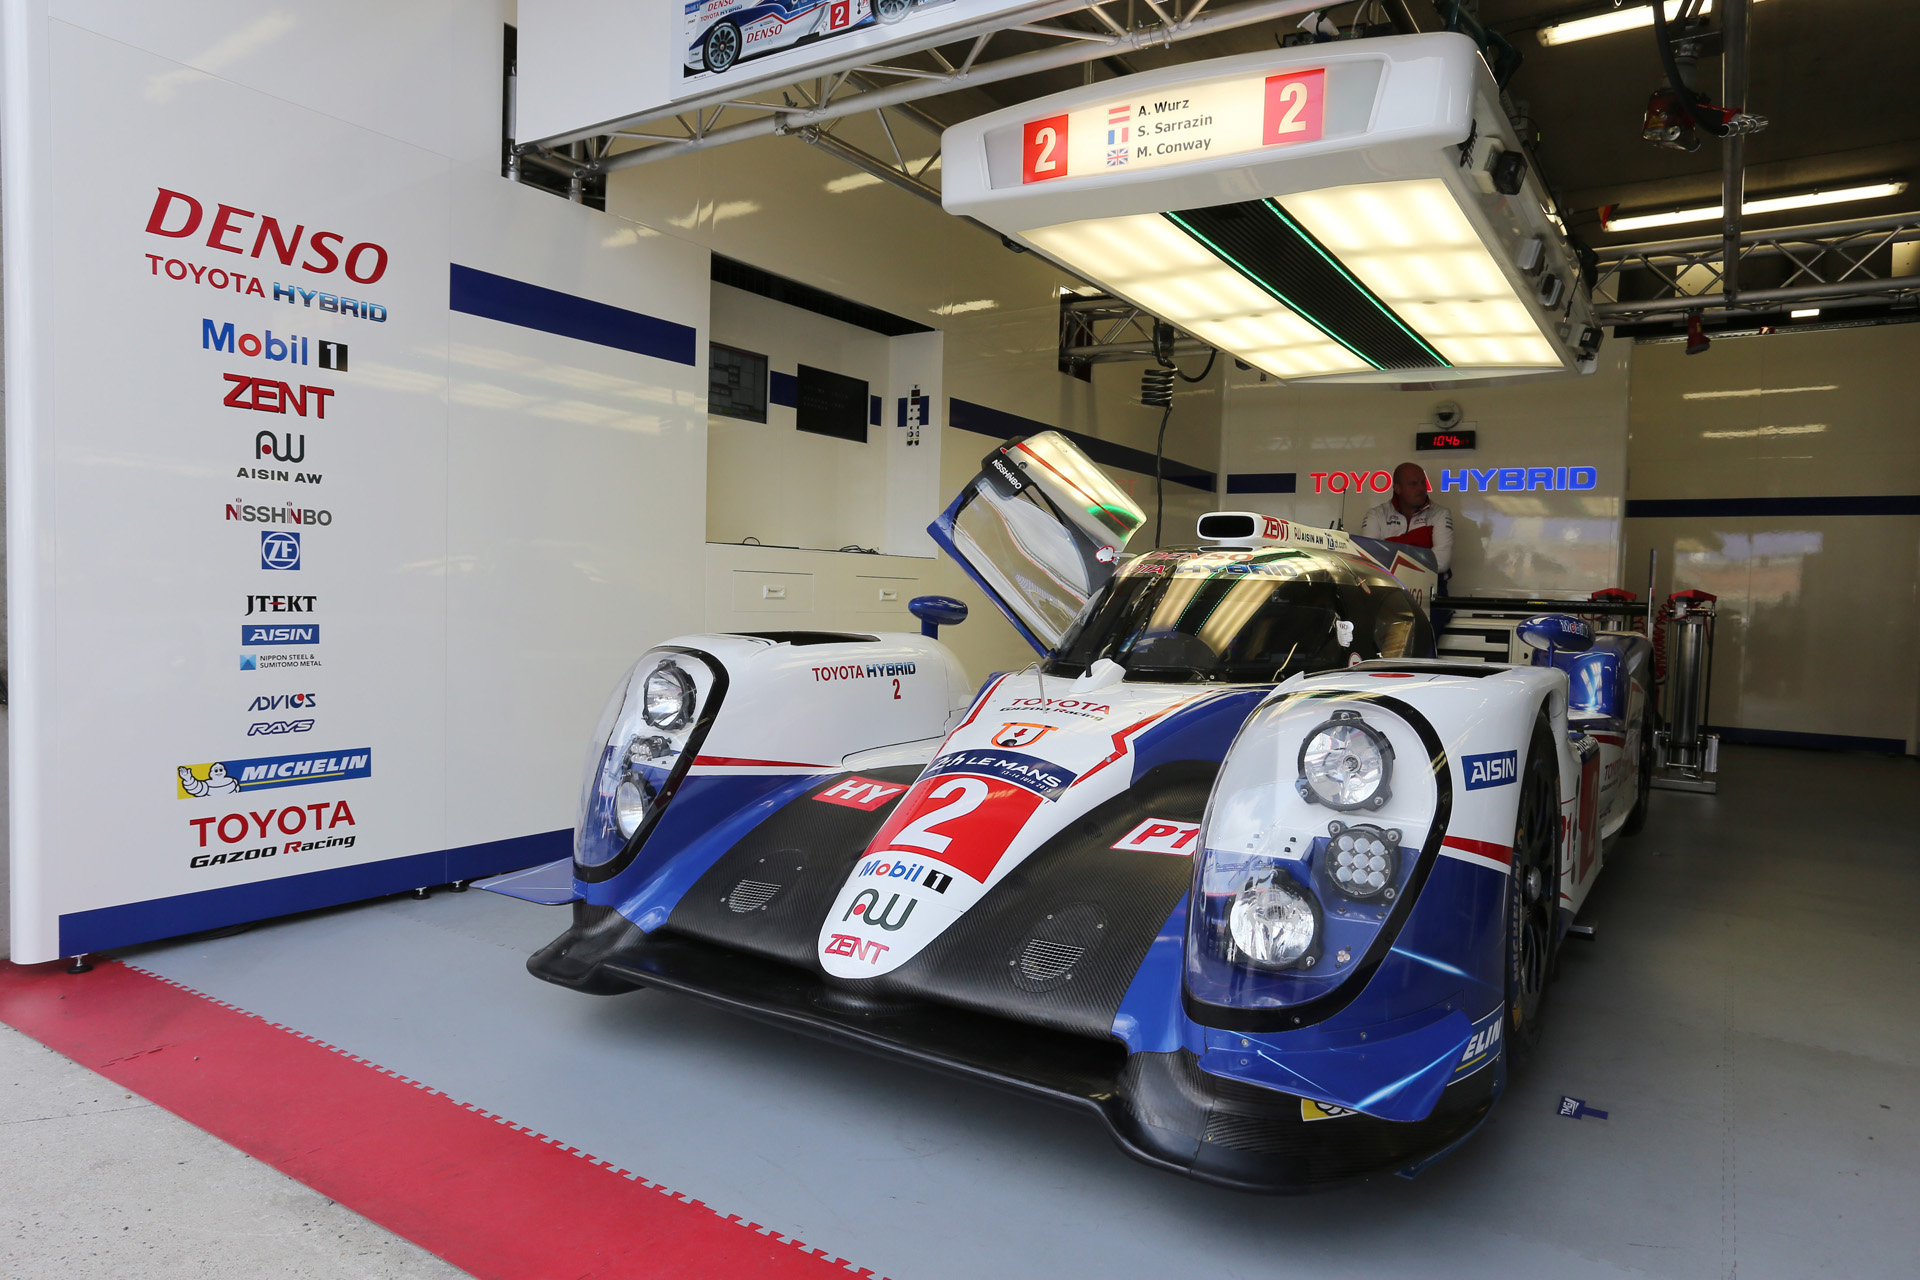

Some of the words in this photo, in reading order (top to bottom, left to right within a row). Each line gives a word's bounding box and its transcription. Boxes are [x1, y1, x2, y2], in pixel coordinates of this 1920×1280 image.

[834, 6, 845, 26] 2
[746, 23, 783, 44] DENSO
[1138, 106, 1151, 117] A.
[1154, 98, 1190, 114] Wurz
[1278, 82, 1308, 135] 2
[1137, 124, 1150, 137] S.
[1154, 114, 1213, 135] Sarrazin
[1034, 127, 1056, 173] 2
[1136, 146, 1152, 158] M.
[1156, 136, 1212, 156] Conway
[145, 187, 388, 285] DENSO
[145, 253, 266, 298] TOYOTA
[273, 282, 388, 323] HYBRID
[202, 318, 308, 365] Mobil
[223, 372, 335, 419] ZENT
[237, 467, 290, 482] AISIN
[295, 472, 323, 485] AW
[1310, 470, 1433, 494] TOYO
[1440, 466, 1598, 492] HYBRID
[1261, 515, 1289, 542] ZENT
[1301, 532, 1315, 544] AISIN
[1144, 552, 1254, 562] DENSO
[1175, 564, 1299, 577] HYBRID
[244, 595, 318, 616] JTEKT
[249, 628, 313, 642] AISIN
[260, 661, 299, 669] SUMITOMO
[812, 665, 864, 681] TOYOTA
[866, 662, 916, 678] HYBRID
[893, 679, 901, 699] 2
[1011, 698, 1110, 715] TOYOTA
[1053, 708, 1105, 721] Racing
[247, 719, 315, 736] RAYS
[240, 754, 368, 782] MICHELIN
[966, 757, 994, 766] LE
[994, 759, 1062, 787] MANS
[1470, 758, 1515, 783] AISIN
[826, 780, 894, 804] HY
[189, 800, 355, 847] TOYOTA
[891, 778, 989, 853] 2
[1132, 824, 1200, 849] P1
[190, 846, 277, 869] GAZOO
[283, 835, 356, 854] Racing
[858, 860, 924, 882] Mobil
[825, 934, 889, 965] ZENT
